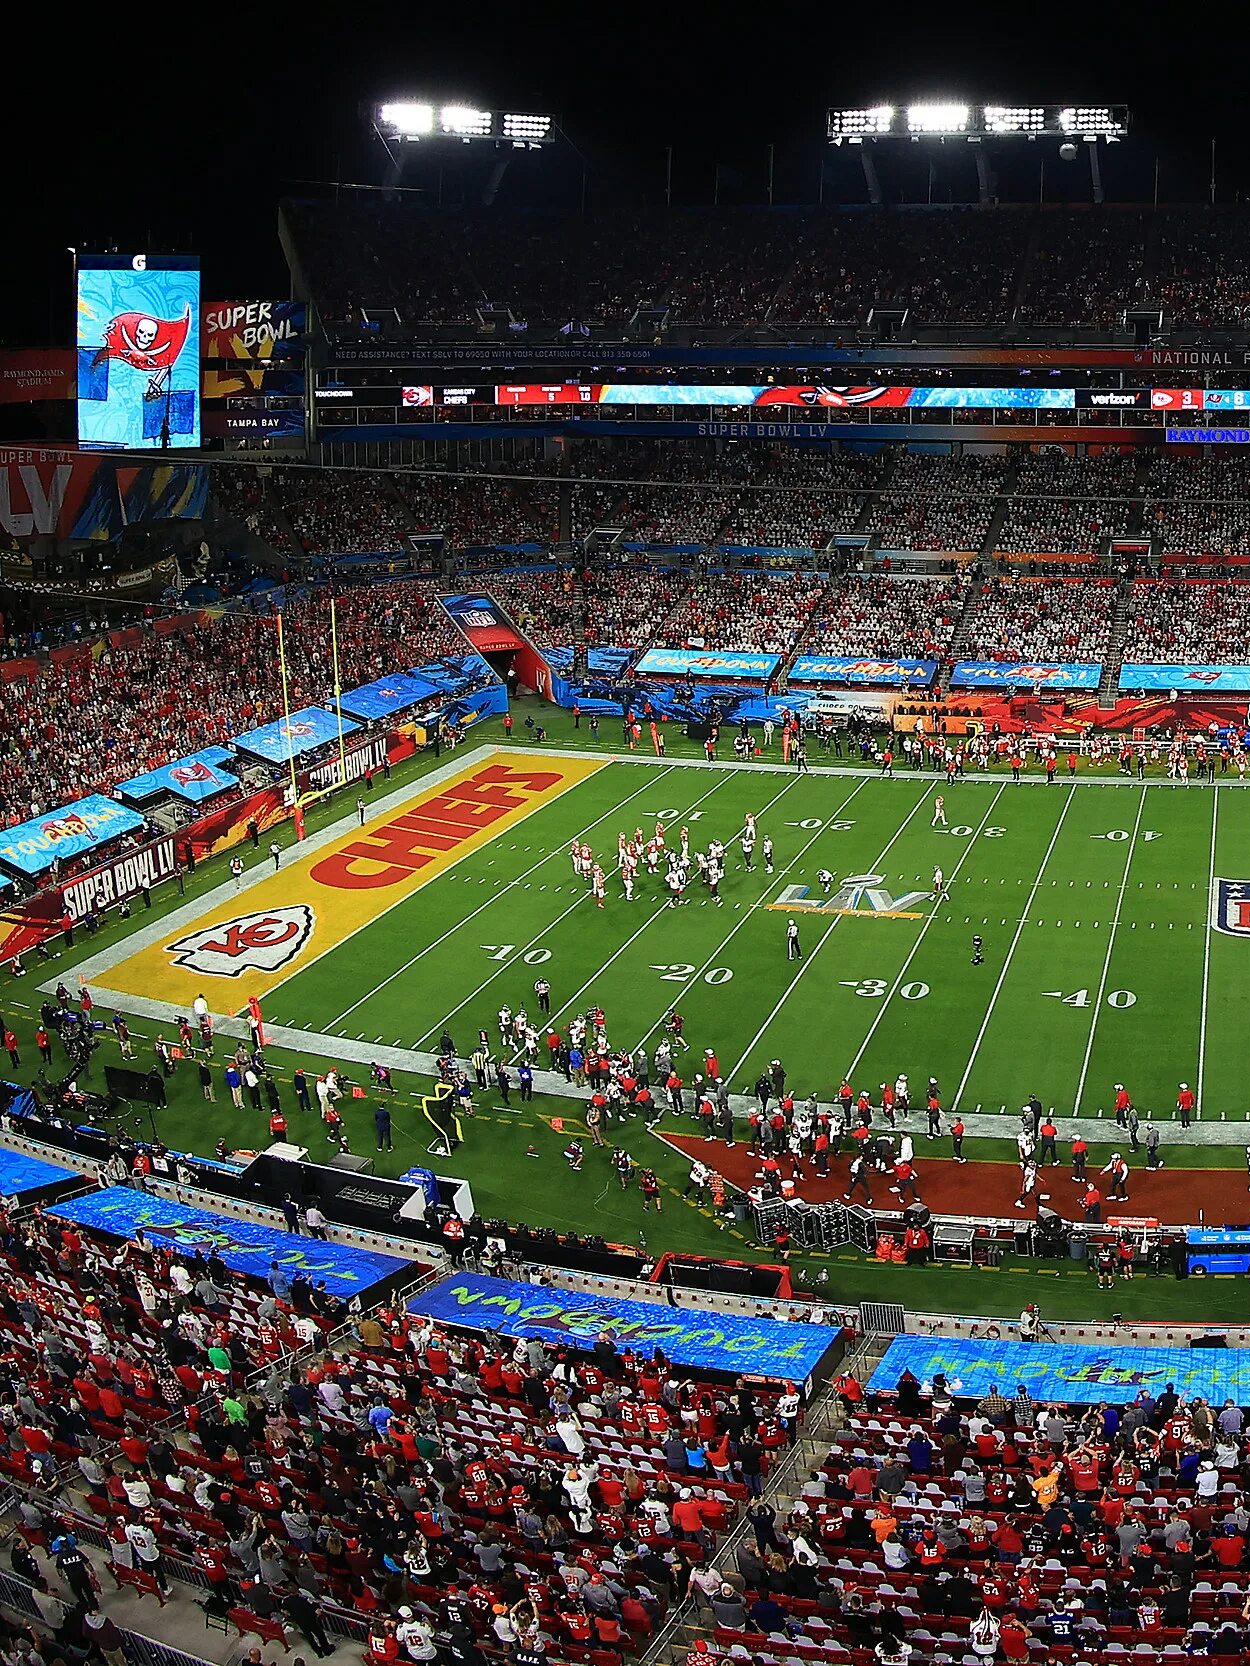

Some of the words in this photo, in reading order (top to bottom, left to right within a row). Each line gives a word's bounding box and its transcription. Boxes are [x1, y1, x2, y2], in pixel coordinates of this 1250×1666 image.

[132, 255, 146, 271] G
[206, 302, 272, 333] SUPER
[242, 320, 298, 349] BOWL
[335, 351, 357, 359] NEED
[358, 351, 410, 359] ASSISTANCE?
[412, 351, 431, 359] TEXT
[513, 350, 533, 358] YOUR
[534, 350, 572, 358] LOCATION
[582, 350, 600, 358] CALL
[1152, 352, 1232, 365] NATIONAL
[16, 377, 52, 387] STADIUM
[514, 393, 519, 402] 1
[548, 393, 555, 402] 5
[1091, 392, 1135, 406] verizon
[1181, 391, 1192, 405] 3
[227, 418, 257, 428] TAMPA
[259, 418, 280, 428] BAY
[697, 424, 749, 437] SUPER
[757, 424, 800, 437] BOWL
[808, 425, 827, 438] LV
[1167, 429, 1250, 443] RAYMOND
[0, 451, 34, 464] UPER
[40, 450, 74, 462] BOWL
[645, 654, 770, 673] TOUCHDOWN
[801, 660, 927, 678] TOUCHDOWN
[656, 808, 708, 821] 10
[310, 764, 564, 889] CHIEFS
[798, 818, 856, 831] 20
[949, 825, 1007, 838] 30
[1106, 829, 1163, 842] 40
[158, 838, 175, 876] LV
[197, 918, 300, 957] KC
[486, 944, 553, 965] 10
[659, 963, 734, 985] 20
[855, 978, 931, 1000] 30
[1061, 989, 1137, 1009] 40
[449, 1286, 805, 1359] TOUCHDOWN
[262, 1335, 272, 1344] 15
[658, 1366, 667, 1374] 12
[585, 1375, 597, 1384] 12
[621, 1410, 633, 1422] 12
[649, 1413, 659, 1423] 15
[547, 1424, 557, 1433] 12
[472, 1470, 486, 1481] 68
[1118, 1477, 1133, 1486] 87
[640, 1528, 651, 1537] 12
[923, 1547, 937, 1557] 15
[1091, 1543, 1106, 1555] 12
[474, 1599, 488, 1610] 47
[449, 1612, 460, 1622] 12
[1143, 1615, 1155, 1624] 15
[1053, 1624, 1071, 1634] 21
[372, 1641, 385, 1653] 15
